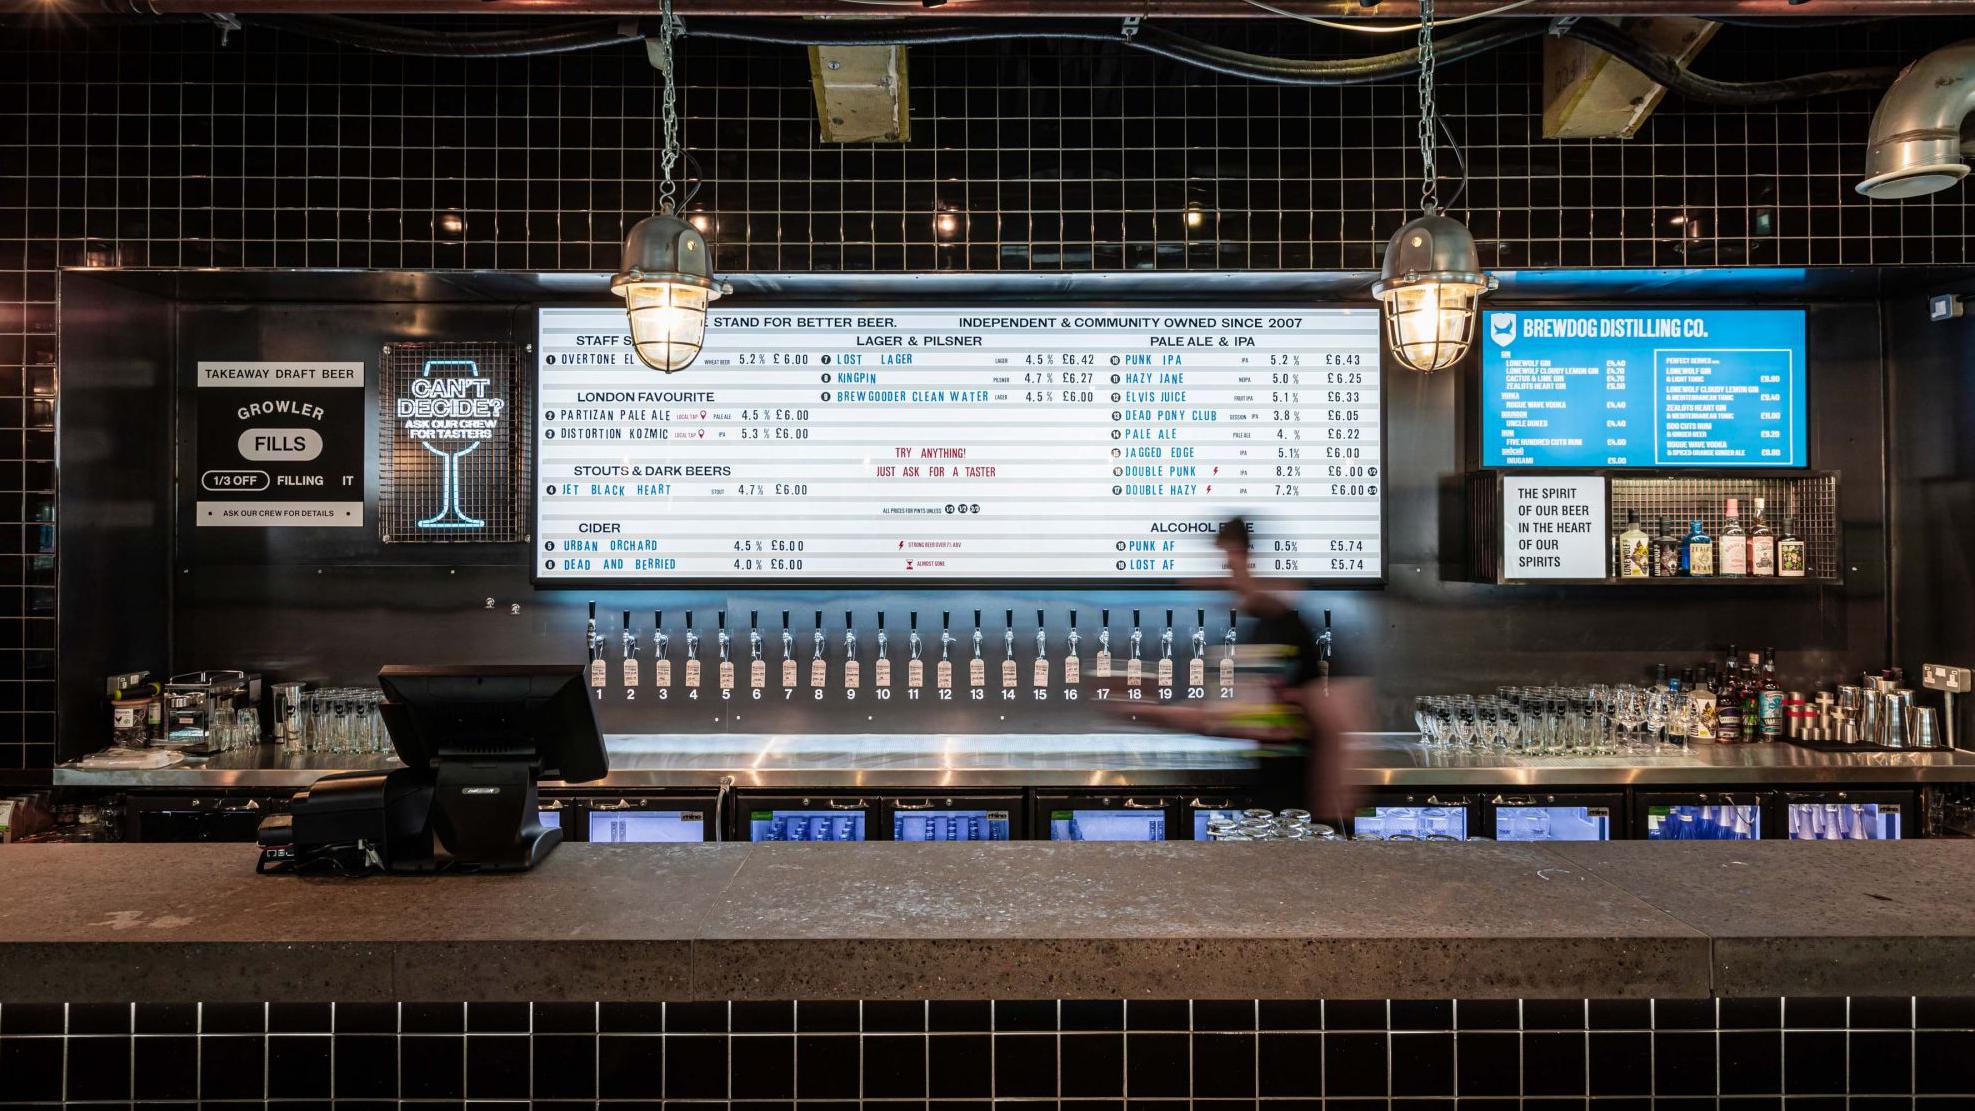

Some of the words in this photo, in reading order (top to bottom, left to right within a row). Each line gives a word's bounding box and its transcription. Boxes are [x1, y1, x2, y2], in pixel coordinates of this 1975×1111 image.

[714, 317, 759, 327] STAND
[764, 318, 792, 327] FOR
[797, 318, 852, 327] BETTER
[857, 318, 897, 327] BEER.
[959, 318, 1056, 327] INDEPENDENT
[1061, 318, 1071, 327] &
[1074, 318, 1160, 327] COMMUNITY
[1164, 318, 1217, 327] OWNED
[1222, 319, 1263, 328] SINCE
[1268, 319, 1302, 328] 2007
[1523, 318, 1597, 338] BREWDOG
[1600, 318, 1681, 338] DISTILLING
[1684, 318, 1709, 338] CO.
[576, 336, 619, 345] STAFF
[856, 336, 902, 346] LAGER
[908, 336, 918, 346] &
[924, 336, 982, 346] PILSNER
[1150, 337, 1184, 346] PALE
[1187, 337, 1213, 346] ALE
[1219, 337, 1229, 346] &
[1234, 337, 1255, 346] IPA
[561, 354, 616, 364] OVERTONE
[837, 354, 862, 365] LOST
[881, 354, 913, 364] LAGER
[1062, 354, 1094, 364] £6.42
[1125, 355, 1152, 365] PUNK
[1162, 355, 1182, 365] IPA
[205, 369, 269, 378] TAKEAWAY
[275, 369, 316, 378] DRAFT
[322, 369, 354, 378] BEER
[838, 373, 876, 384] KINGPIN
[1062, 373, 1093, 384] £6.27
[1126, 373, 1152, 384] HAZY
[1160, 373, 1184, 384] JANE
[411, 378, 490, 398] CAN'T
[577, 392, 635, 402] LONDON
[638, 392, 715, 402] FAVOURITE
[912, 391, 944, 402] CLEAN
[1126, 392, 1155, 402] ELVIS
[1161, 392, 1186, 402] JUICE
[1328, 392, 1359, 402] £6.33
[237, 400, 324, 420] GROWLER
[398, 398, 504, 418] DECIDE?
[1125, 410, 1151, 421] DEAD
[1158, 410, 1185, 421] PONY
[1192, 410, 1217, 421] CLUB
[1328, 410, 1359, 421] £6.05
[405, 420, 429, 429] ASK
[431, 420, 458, 429] OUR
[459, 420, 497, 429] CREW
[410, 429, 436, 438] FOR
[441, 429, 492, 438] TASTERS
[561, 428, 621, 439] DISTORTION
[776, 428, 809, 439] £6.00
[1125, 429, 1151, 439] PALE
[1158, 429, 1177, 439] ALE
[1328, 429, 1360, 439] £6.22
[255, 437, 306, 451] FILLS
[896, 448, 911, 458] TRY
[921, 448, 966, 458] ANYTHING!
[1125, 447, 1161, 458] JAGGED
[1171, 447, 1194, 458] EDGE
[574, 466, 629, 476] STOUTS
[632, 466, 642, 476] &
[645, 466, 682, 476] DARK
[685, 466, 731, 476] BEERS
[876, 467, 895, 477] JUST
[902, 467, 919, 477] ASK
[929, 467, 944, 477] FOR
[953, 467, 959, 477] A
[965, 467, 996, 477] TASTER
[1125, 466, 1163, 476] DOUBLE
[1170, 466, 1196, 476] PUNK
[214, 475, 231, 485] 1/3
[233, 475, 257, 485] OFF
[277, 475, 324, 485] FILLING
[342, 475, 354, 485] IT
[562, 484, 579, 495] JET
[591, 484, 624, 496] BLACK
[637, 484, 671, 495] HEART
[775, 484, 808, 495] £6.00
[1125, 485, 1163, 495] DOUBLE
[1170, 485, 1197, 495] HAZY
[1331, 484, 1364, 495] £6.00
[1518, 488, 1539, 499] THE
[1542, 488, 1576, 499] SPIRIT
[1518, 505, 1533, 516] OF
[1535, 505, 1559, 516] OUR
[1562, 505, 1589, 516] BEER
[578, 523, 620, 533] CIDER
[1151, 523, 1217, 533] ALCOHOL
[1518, 522, 1529, 533] IN
[1532, 522, 1553, 533] THE
[1556, 522, 1591, 533] HEART
[564, 540, 598, 551] URBAN
[610, 540, 657, 551] ORCHARD
[1129, 541, 1155, 551] PUNK
[1162, 541, 1175, 551] AF
[1330, 540, 1363, 551] £5.74
[1518, 539, 1533, 550] OF
[1536, 539, 1559, 550] OUR
[564, 559, 590, 570] DEAD
[603, 559, 623, 570] AND
[635, 558, 676, 570] BERRIED
[1130, 560, 1155, 570] LOST
[1162, 560, 1175, 570] AF
[1331, 559, 1363, 570] £5.74
[1519, 557, 1561, 568] SPIRITS
[596, 689, 602, 700] 1
[659, 689, 668, 700] 3
[785, 689, 792, 700] 7
[876, 689, 890, 700] 10
[907, 688, 919, 699] 11
[970, 688, 984, 699] 13
[1033, 688, 1047, 700] 15
[1097, 688, 1110, 699] 17
[1188, 688, 1204, 699] 20
[1220, 688, 1234, 699] 21
